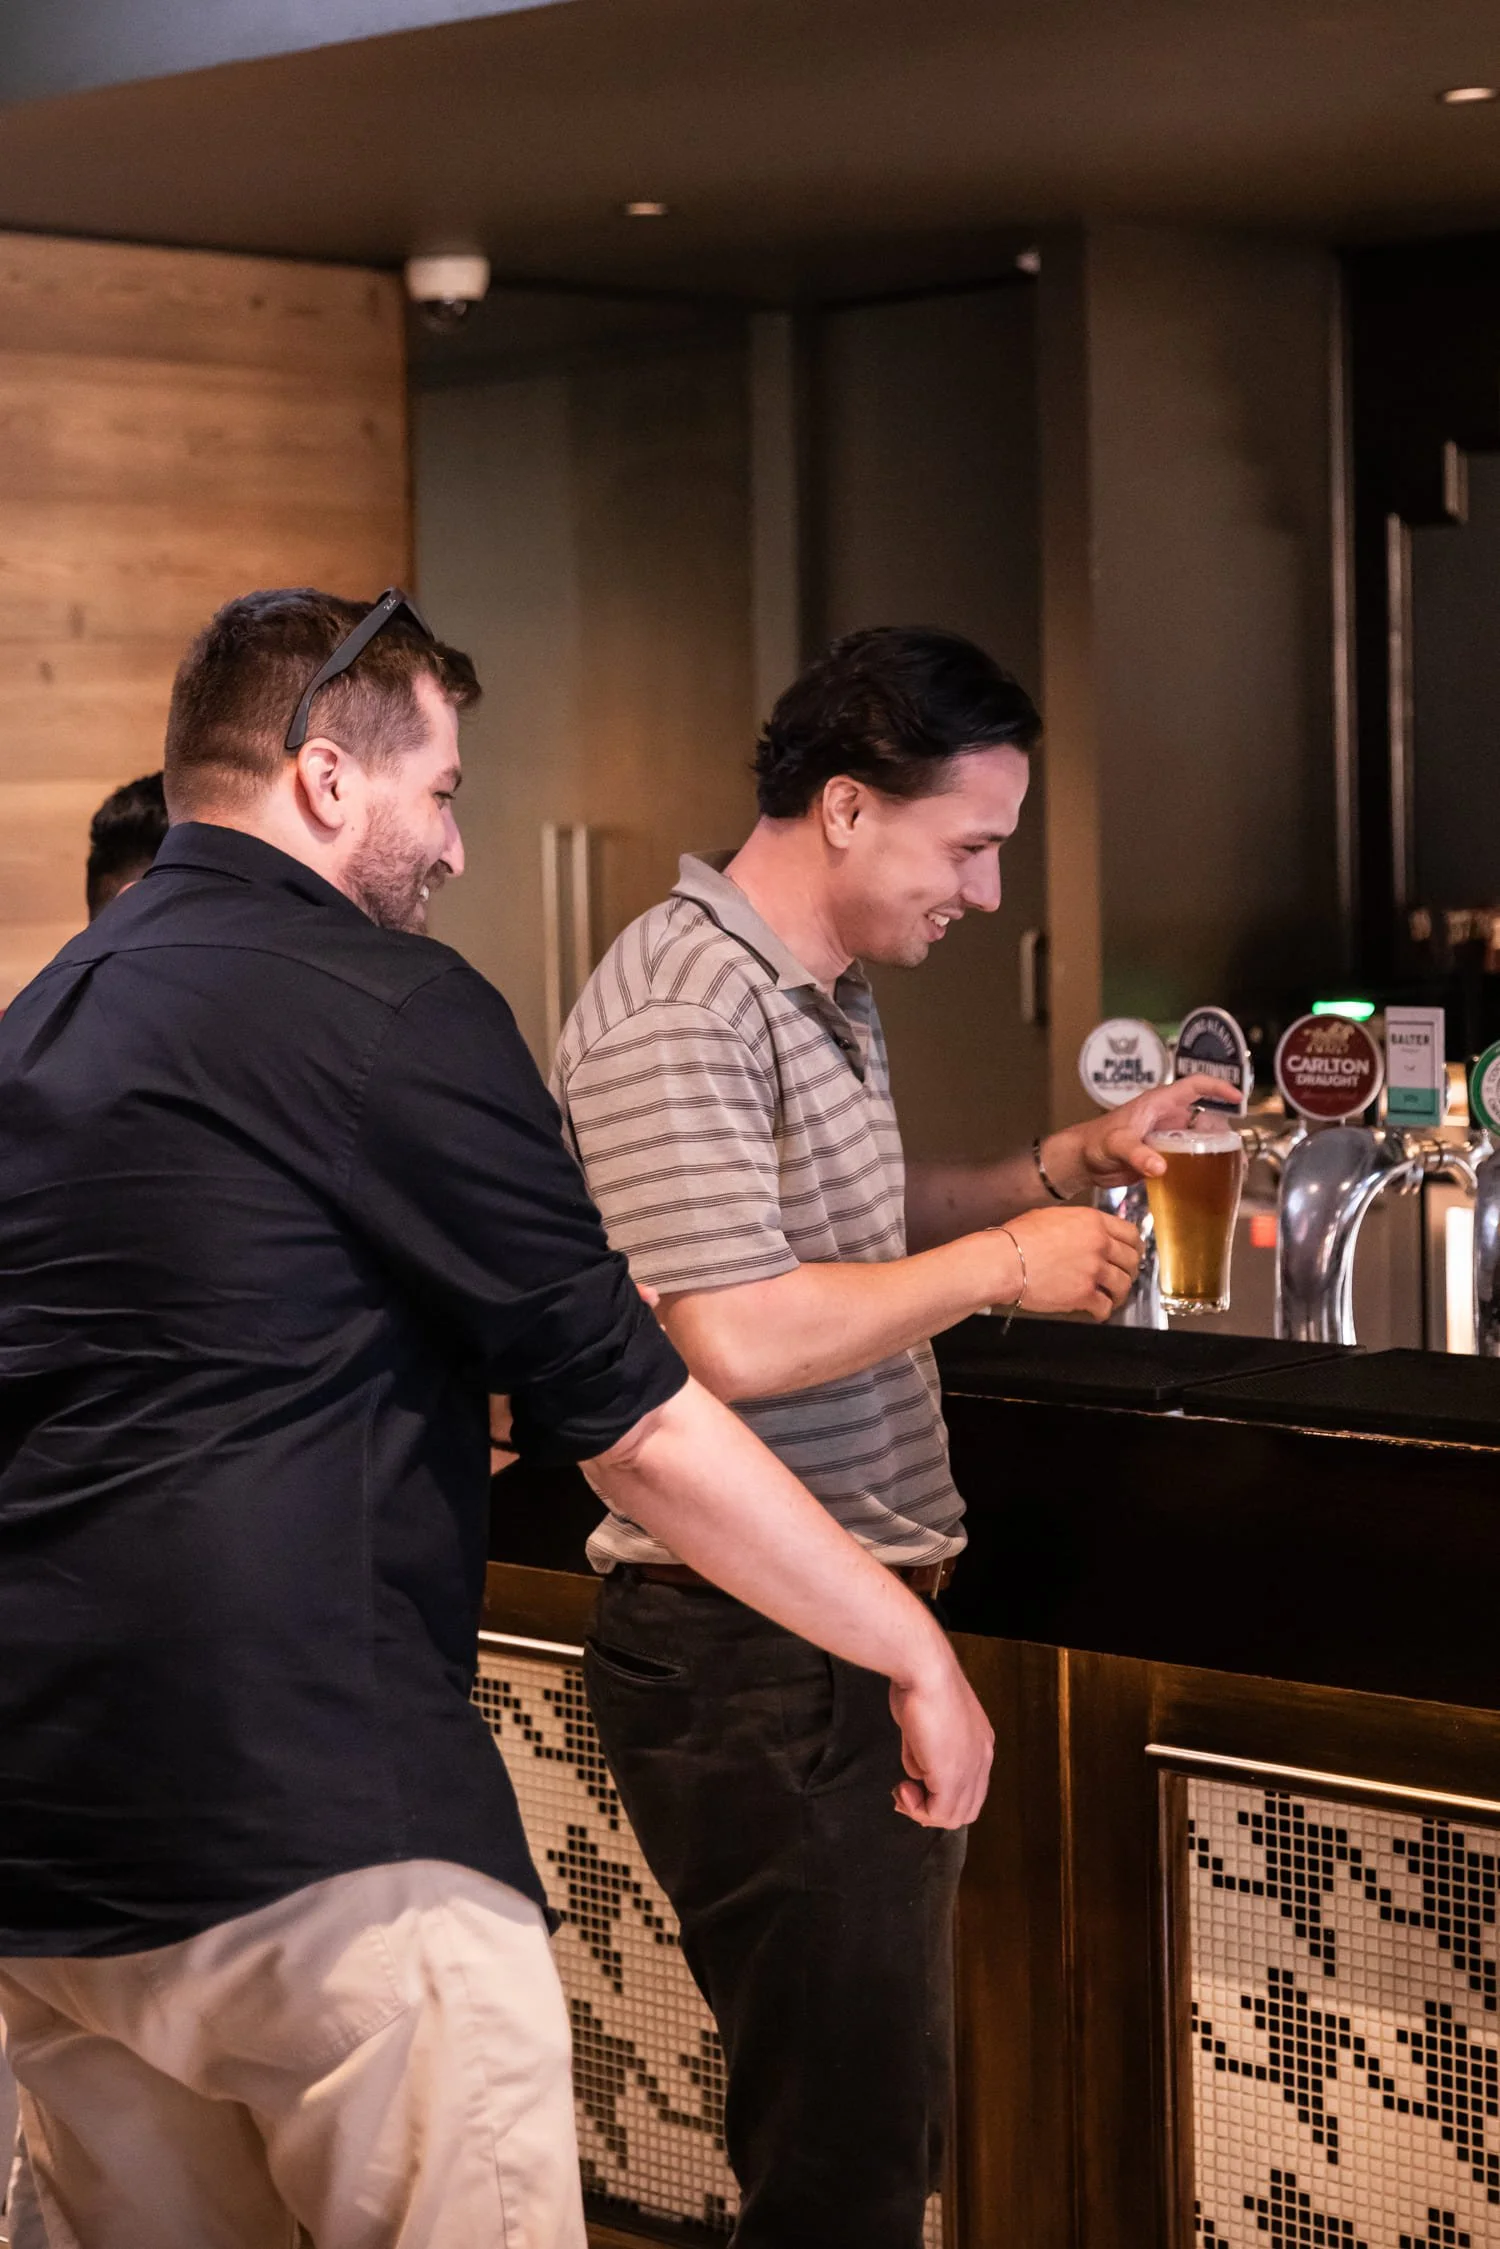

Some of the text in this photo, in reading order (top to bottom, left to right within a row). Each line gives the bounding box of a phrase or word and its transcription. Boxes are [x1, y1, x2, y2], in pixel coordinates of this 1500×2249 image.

[1391, 1033, 1430, 1046] BALTER
[1103, 1058, 1143, 1070] PURE
[1286, 1055, 1370, 1075] CARLTON
[1093, 1071, 1155, 1084] BLONDE
[1294, 1074, 1360, 1088] DRAUGHT
